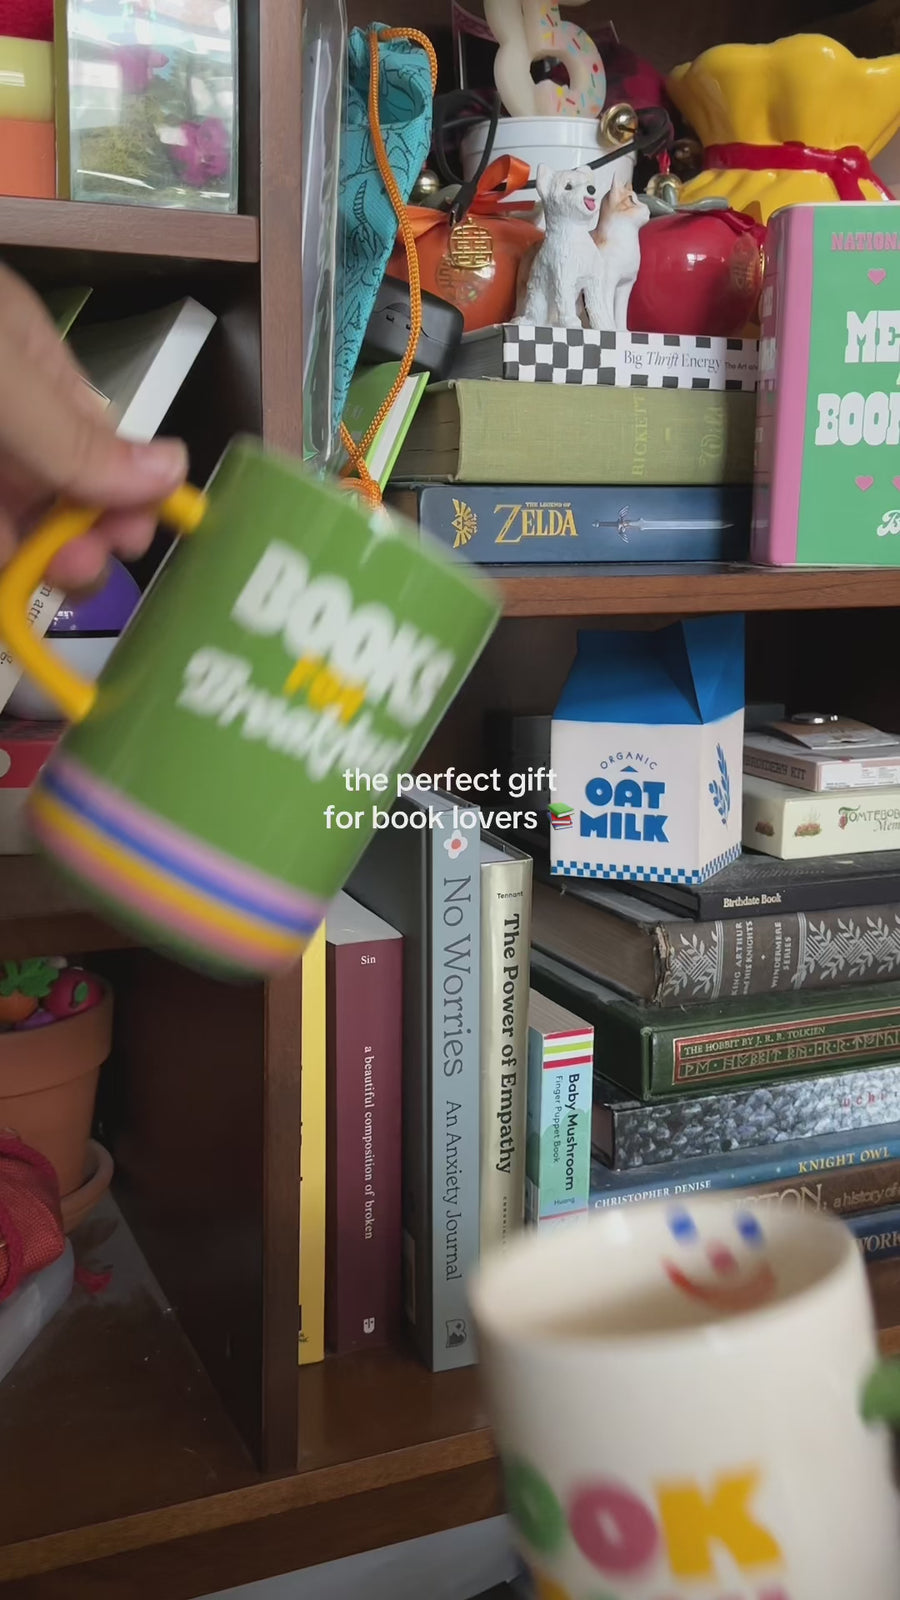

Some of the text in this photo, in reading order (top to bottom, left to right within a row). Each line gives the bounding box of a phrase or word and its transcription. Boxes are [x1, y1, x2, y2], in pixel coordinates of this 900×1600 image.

[831, 231, 900, 252] NATION
[624, 350, 643, 369] Big
[646, 351, 680, 367] Thrift
[681, 353, 720, 374] Energy
[631, 391, 648, 476] RICKETT
[494, 503, 578, 543] ZELDA
[232, 540, 456, 728] BOOKS
[600, 752, 658, 770] ORGANIC
[585, 776, 666, 809] OAT
[580, 811, 670, 843] MILK
[497, 891, 524, 900] Tennant
[723, 893, 781, 908] Birthdate Book
[731, 921, 743, 996] KING ARTHUR
[745, 921, 754, 963] KNIGHTS
[771, 921, 782, 988] WINDERMERE
[783, 936, 792, 971] SERIES
[361, 954, 376, 965] Sin
[496, 913, 520, 1174] The Power of Empathy
[684, 1045, 701, 1056] THE
[708, 1040, 739, 1052] HOBBIT
[742, 1036, 753, 1047] BY
[787, 1027, 826, 1040] TOLKIEN
[443, 875, 471, 1280] No Worries An Anxiety Journal
[552, 1076, 563, 1163] Finger Puppet Book
[565, 1073, 579, 1190] Baby Mushroom
[363, 1046, 375, 1239] a beautiful composition of broken
[798, 1147, 890, 1173] KNIGHT OWL
[594, 1180, 711, 1209] CHRISTOPHER DENISE
[842, 1187, 885, 1208] history
